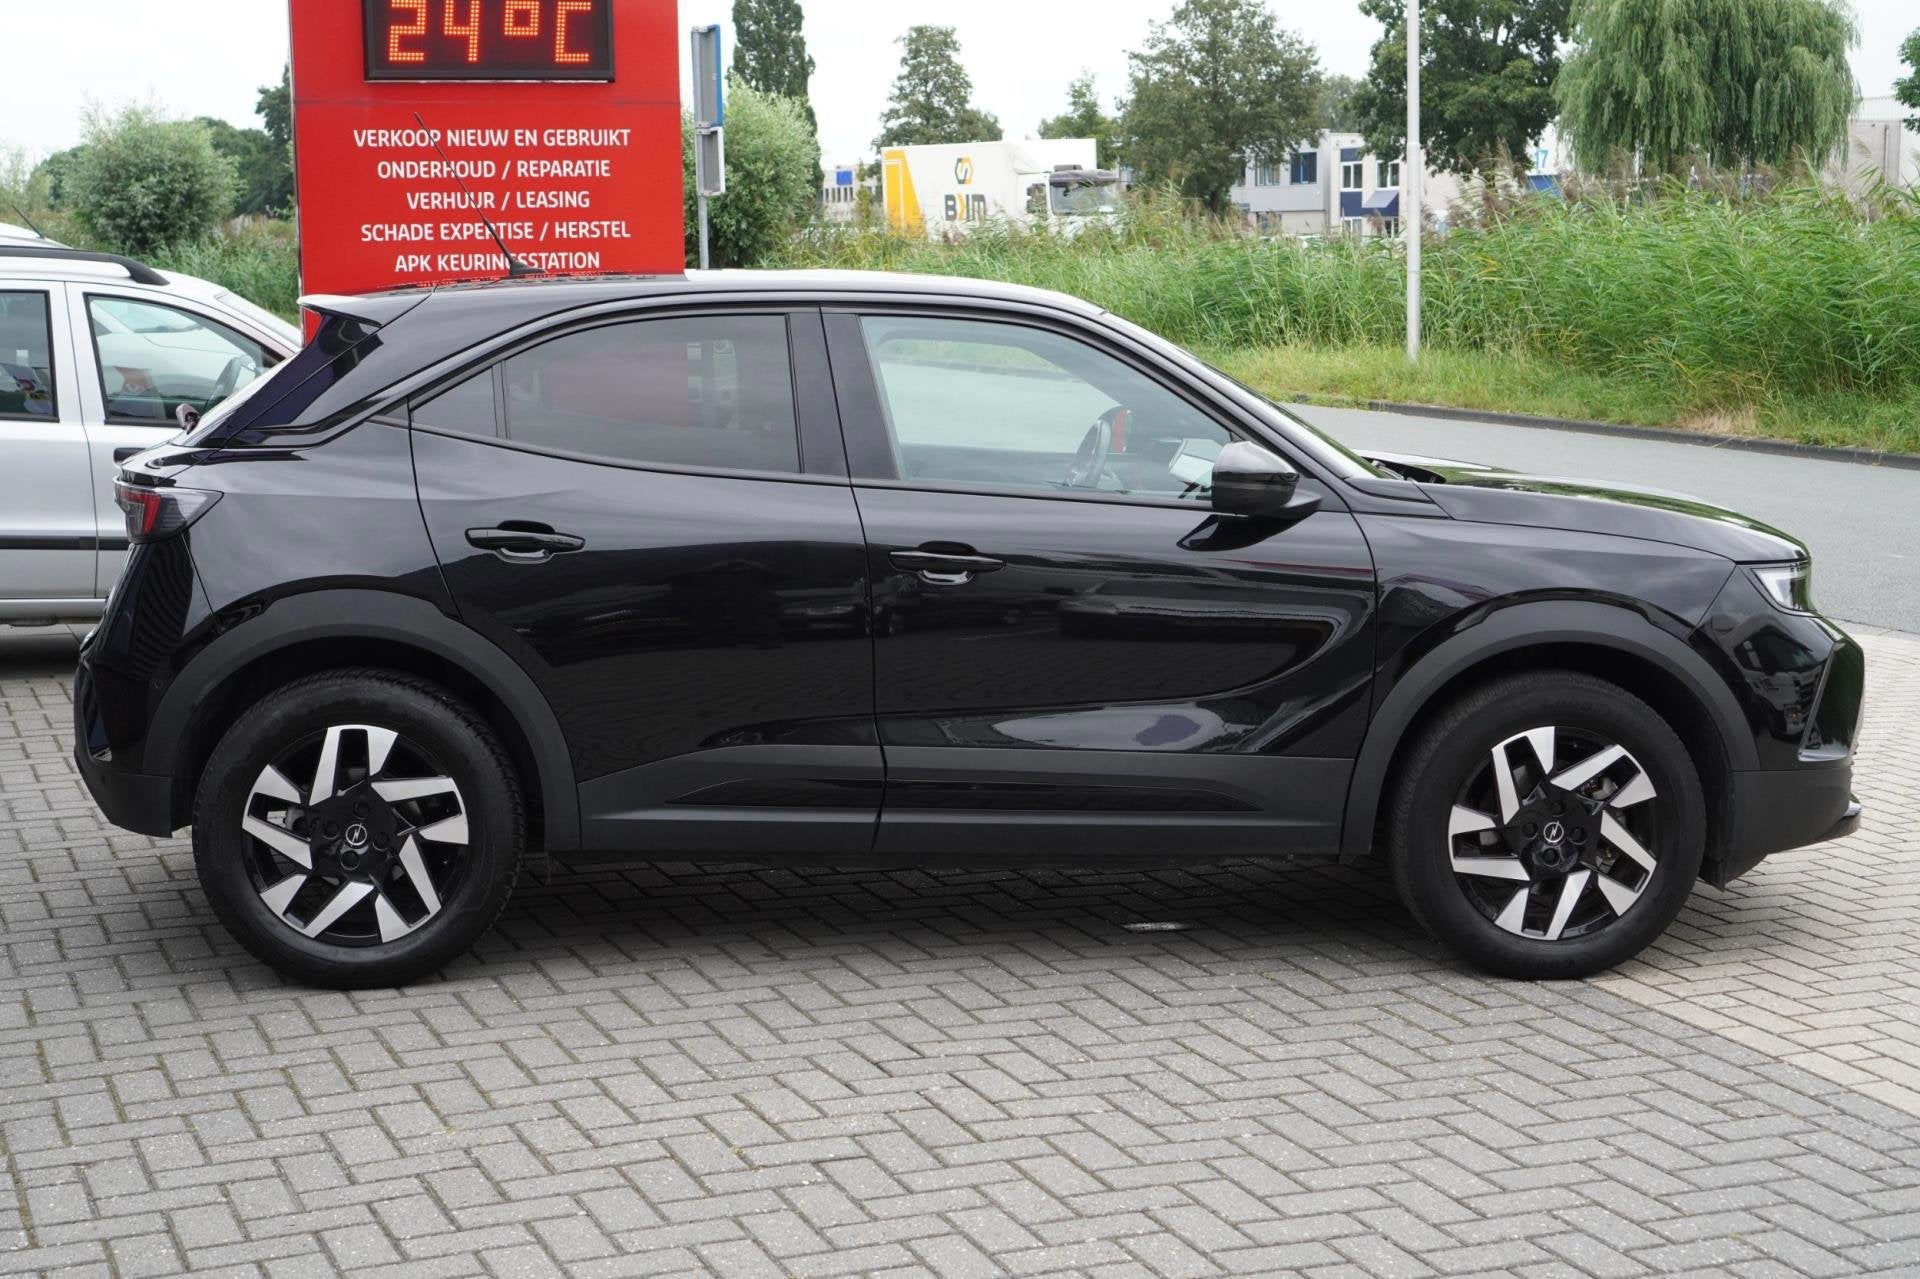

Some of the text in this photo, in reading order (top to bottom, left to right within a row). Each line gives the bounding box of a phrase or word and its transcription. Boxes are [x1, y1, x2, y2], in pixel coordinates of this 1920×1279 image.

[353, 128, 631, 148] VERKOOP NIEUW EN GEBRUIKT
[377, 159, 611, 180] ONDERHOUD / REPARATIE
[406, 190, 590, 211] VERHUUR / LEASING
[361, 220, 631, 242] SCHADE EXPERTISE / HERSTEL
[394, 254, 432, 273] APK
